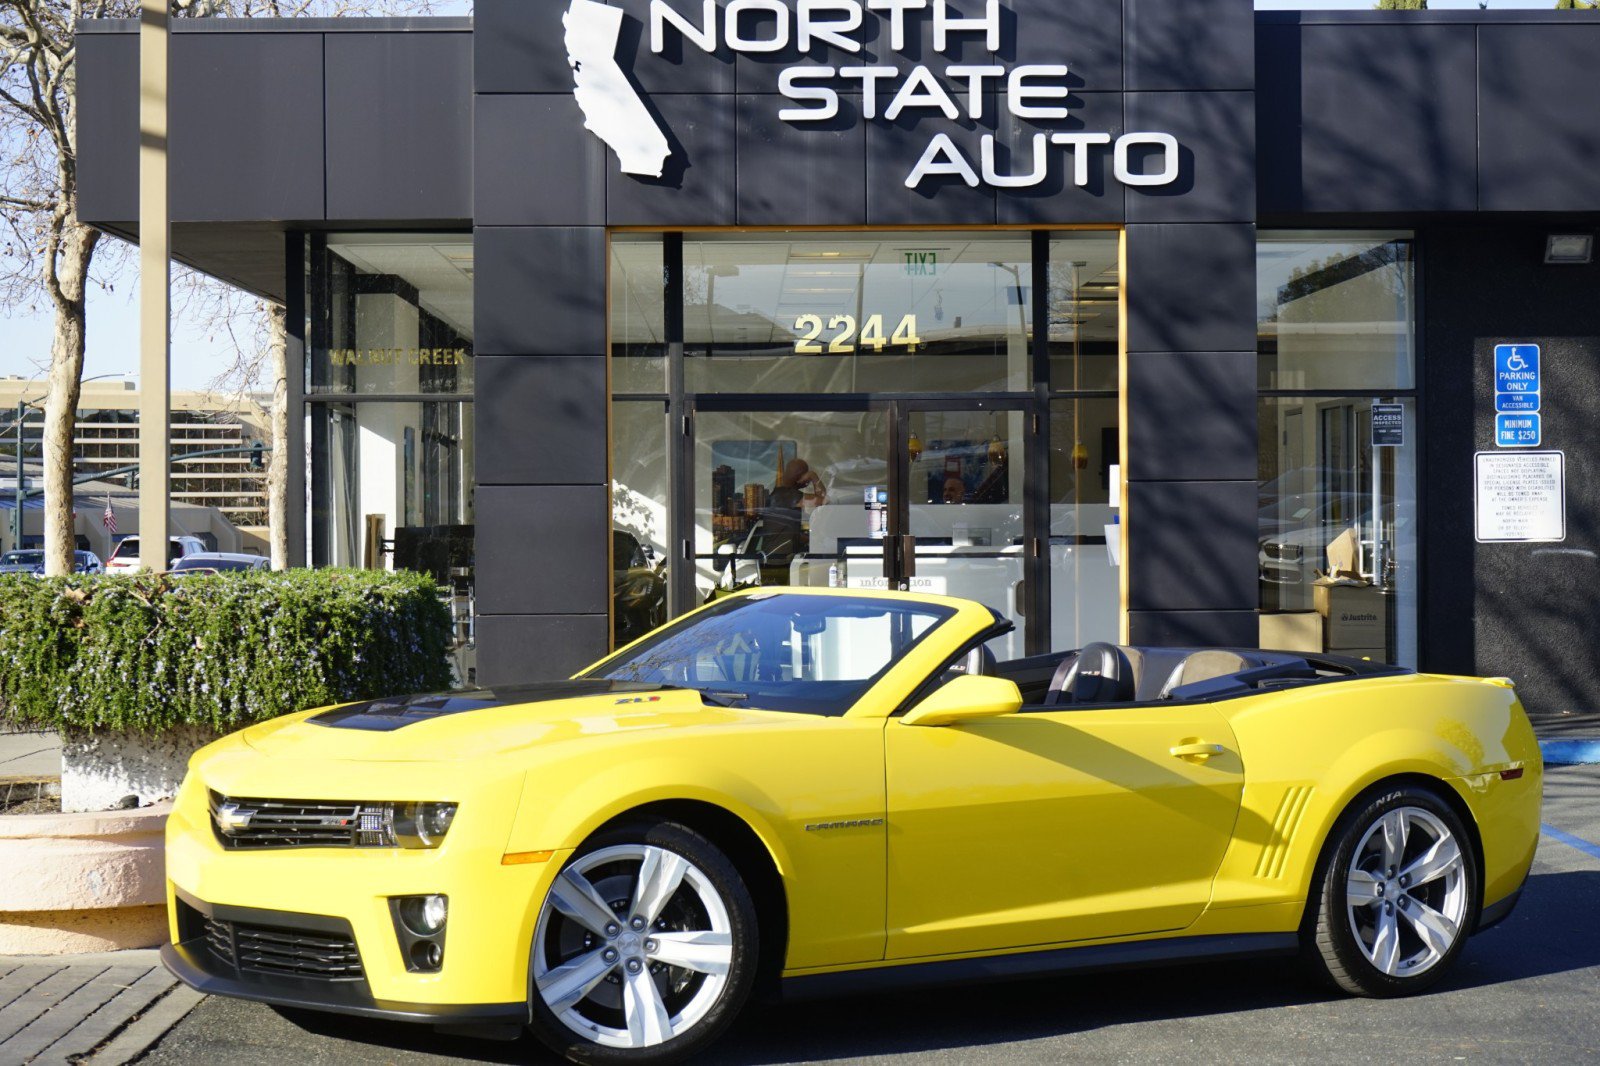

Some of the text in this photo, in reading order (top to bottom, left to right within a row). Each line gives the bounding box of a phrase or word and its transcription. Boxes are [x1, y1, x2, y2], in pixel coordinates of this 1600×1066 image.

[650, 0, 1000, 54] NORTH
[778, 65, 1069, 120] STATE
[904, 132, 1179, 188] AUTO
[794, 313, 921, 353] 2244
[329, 347, 465, 366] WALNUT CREEK
[1499, 371, 1536, 380] PARKING
[1506, 382, 1528, 391] ONLY
[1504, 419, 1532, 429] MINIMUM
[1501, 430, 1536, 441] FINE $250
[860, 576, 932, 587] inforion
[805, 817, 884, 832] CAMARO
